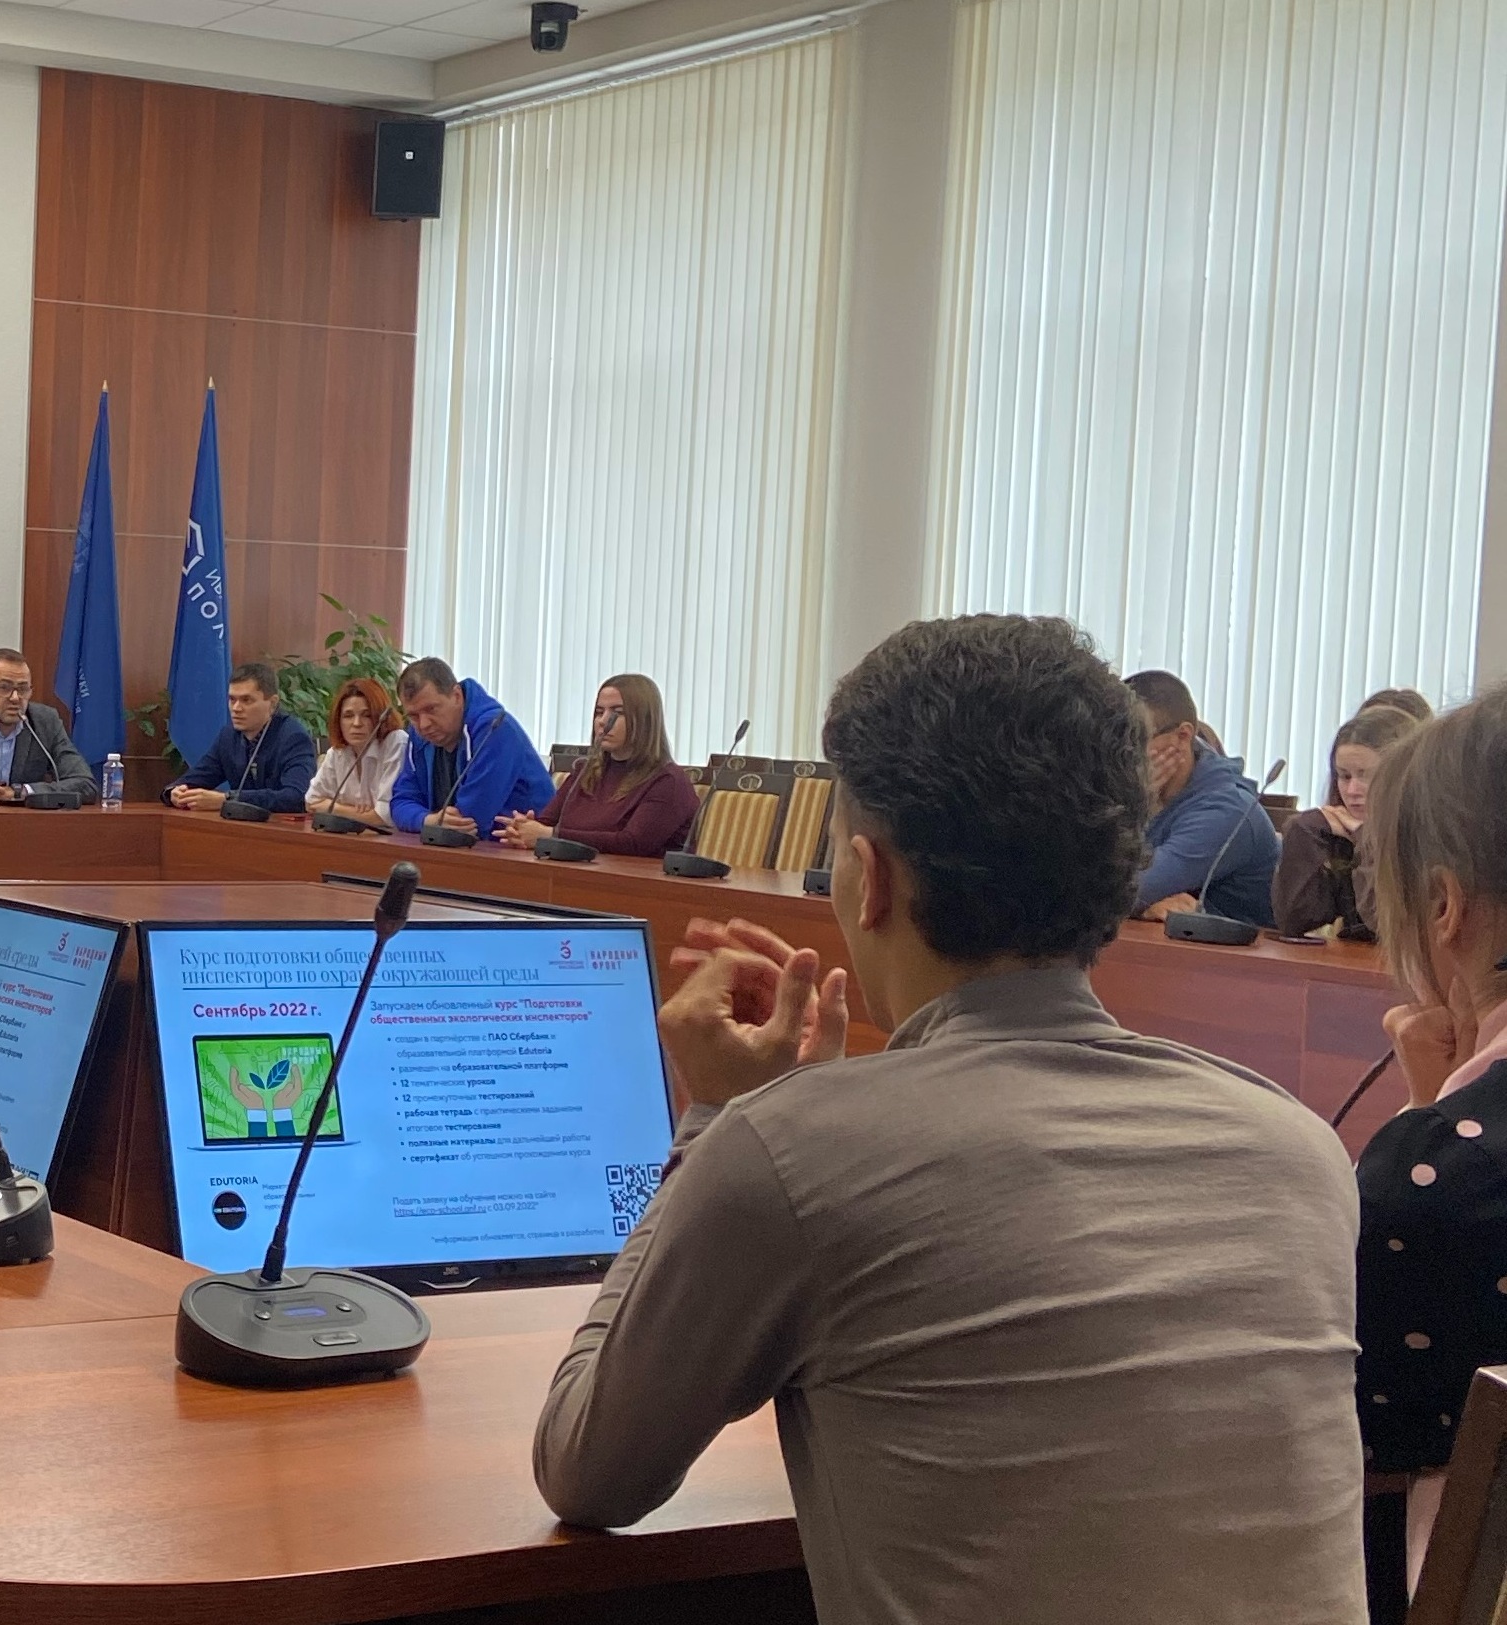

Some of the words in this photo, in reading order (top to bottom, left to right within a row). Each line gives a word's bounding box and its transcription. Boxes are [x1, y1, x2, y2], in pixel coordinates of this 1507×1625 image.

[179, 948, 220, 969] Курс
[223, 949, 322, 968] подготовки
[182, 970, 293, 987] инспекторов
[295, 970, 317, 984] по
[381, 965, 491, 987] окружающей
[493, 967, 540, 986] среды
[193, 1003, 267, 1021] Сентябрь
[269, 1002, 308, 1017] 2022
[310, 1005, 322, 1017] г.
[370, 1000, 424, 1013] Запускаем
[425, 999, 493, 1011] обновленный
[494, 1000, 518, 1012] курс
[370, 1013, 447, 1025] общественных
[447, 1012, 524, 1024] экологических
[487, 1032, 508, 1042] ПАО
[509, 1031, 550, 1043] Сбербанк
[518, 1046, 553, 1056] Edutoria
[451, 1062, 523, 1073] образовательной
[400, 1079, 410, 1088] 12
[402, 1093, 412, 1103] 12
[404, 1108, 440, 1119] рабочая
[440, 1108, 473, 1118] тетрадь
[450, 1138, 496, 1148] материалы
[410, 1152, 459, 1163] сертификат
[210, 1175, 259, 1186] EDUTORIA
